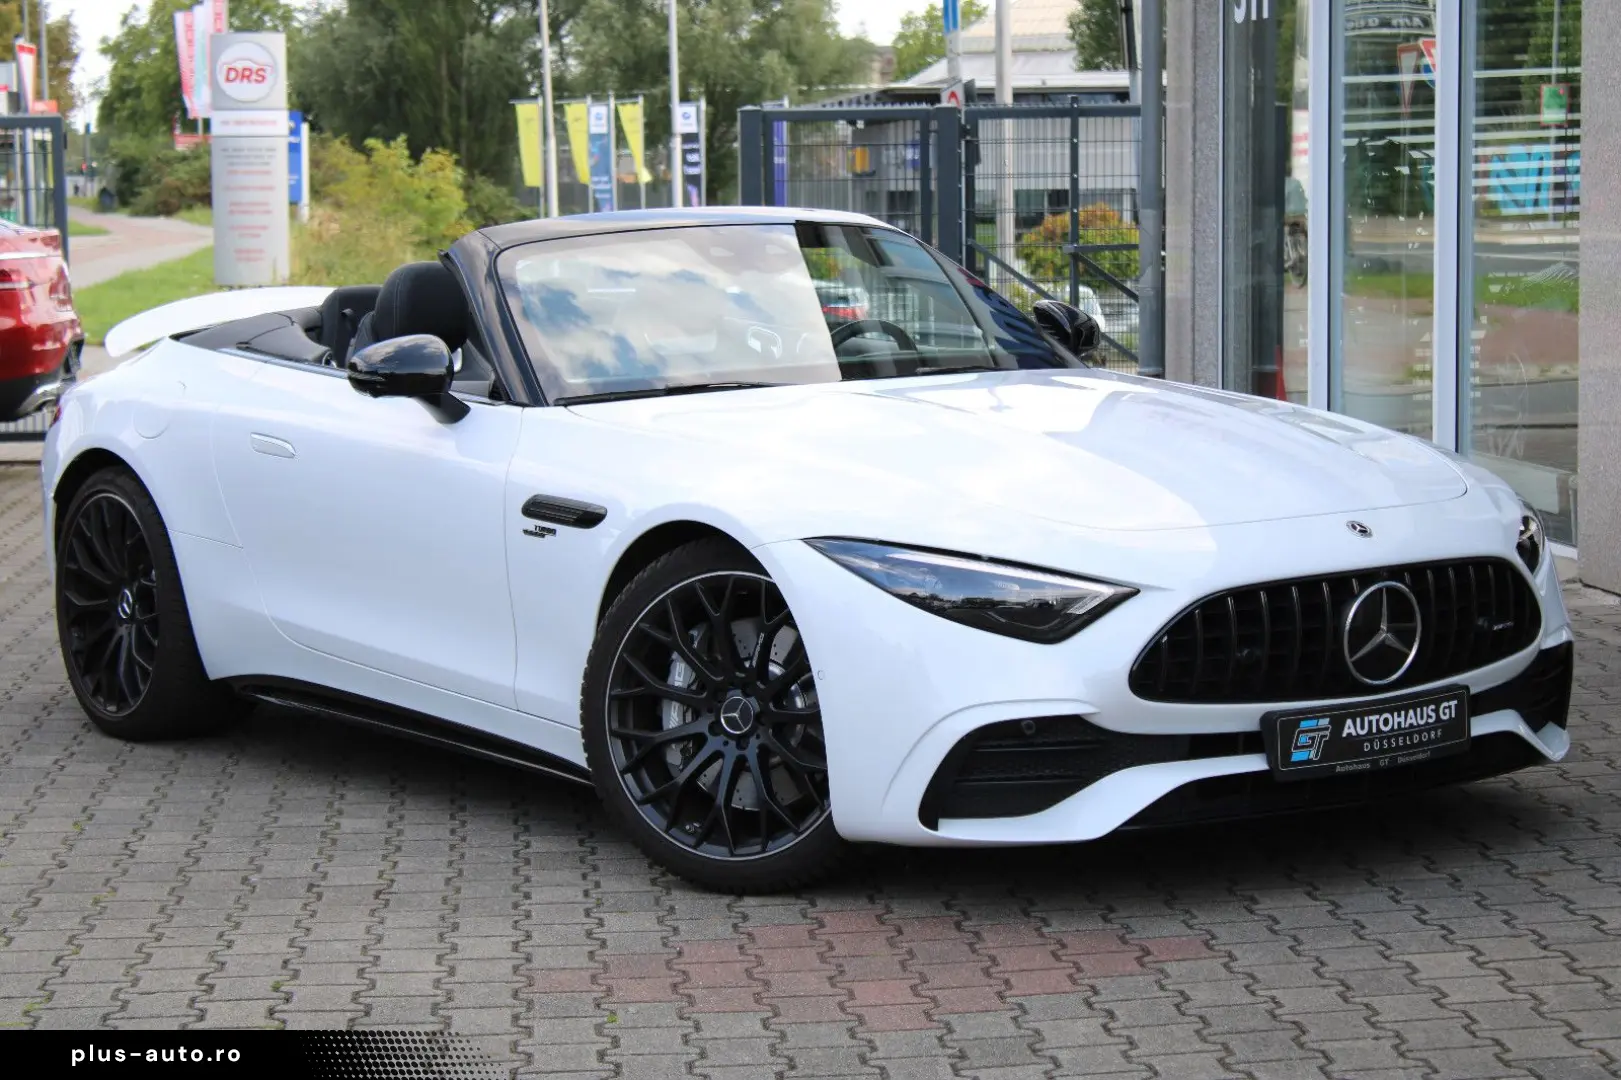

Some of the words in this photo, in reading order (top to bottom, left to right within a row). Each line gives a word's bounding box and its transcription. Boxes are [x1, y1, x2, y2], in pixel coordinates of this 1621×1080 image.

[224, 66, 268, 84] DRS
[1341, 703, 1436, 738] AUTOHAUS
[1439, 700, 1458, 720] GT
[1363, 728, 1443, 752] DÜSSELDORF
[1335, 762, 1371, 773] Autohaus
[1379, 758, 1390, 767] GT
